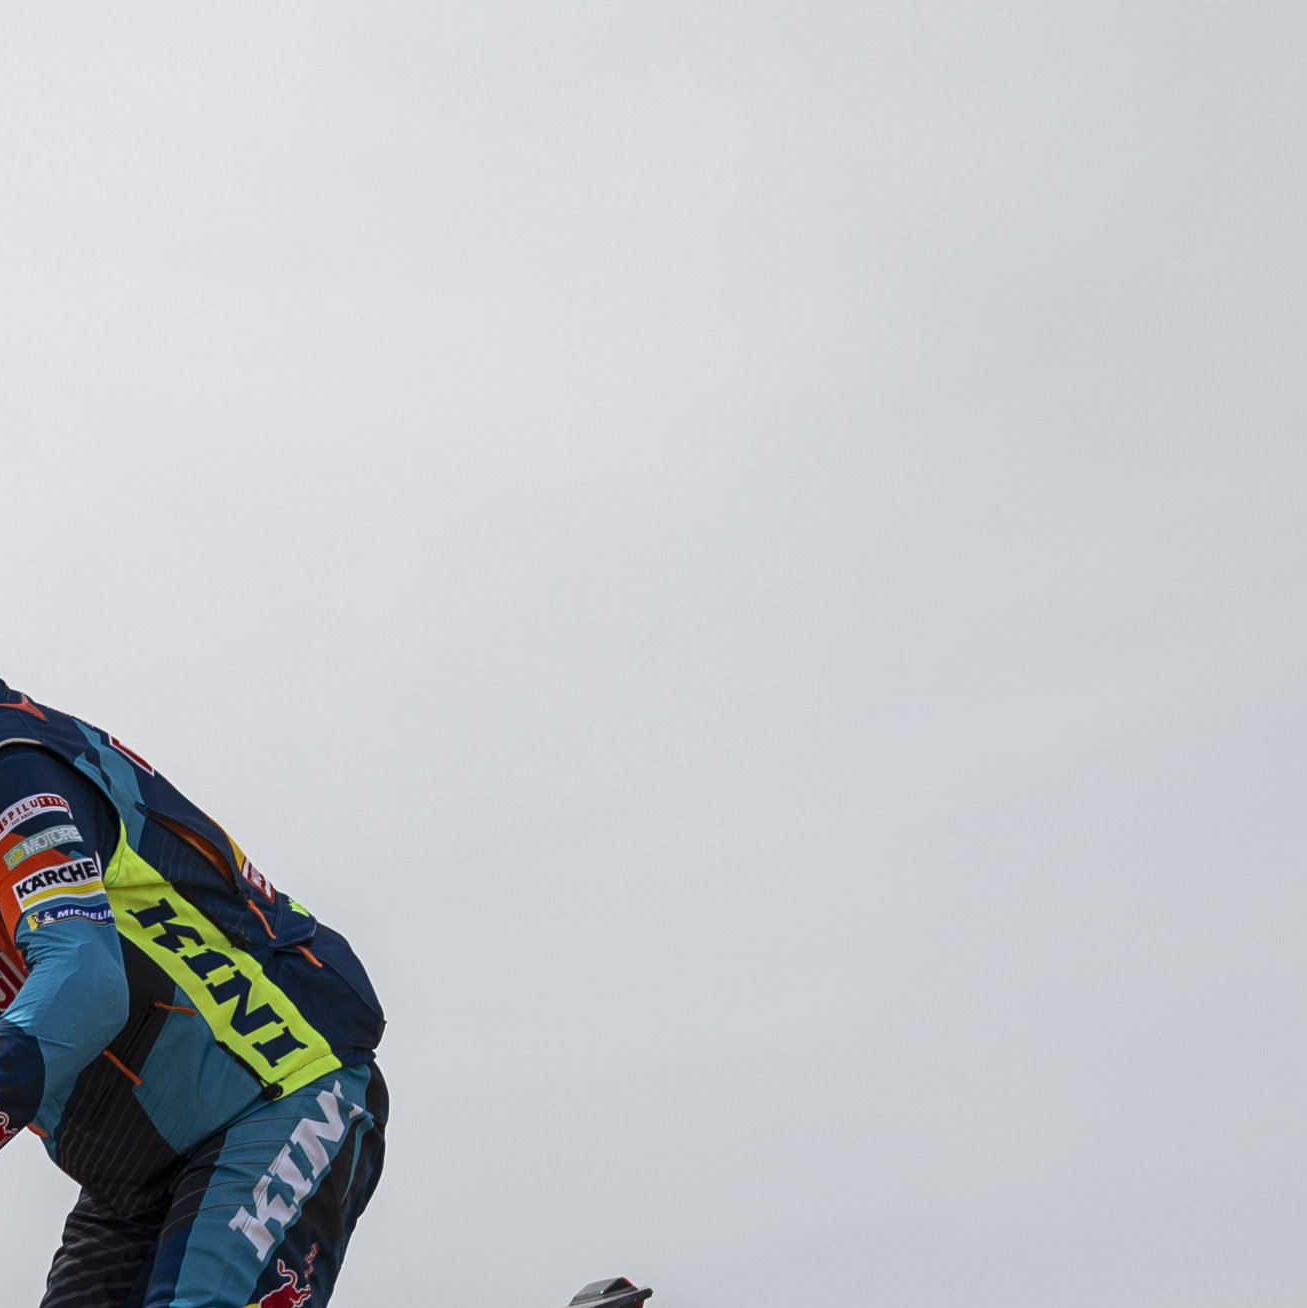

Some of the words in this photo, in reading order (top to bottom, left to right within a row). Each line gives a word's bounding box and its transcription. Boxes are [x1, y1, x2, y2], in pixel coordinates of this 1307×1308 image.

[15, 861, 100, 898] KÄRCHE
[126, 898, 308, 1067] KINI
[228, 1080, 363, 1262] KIN
